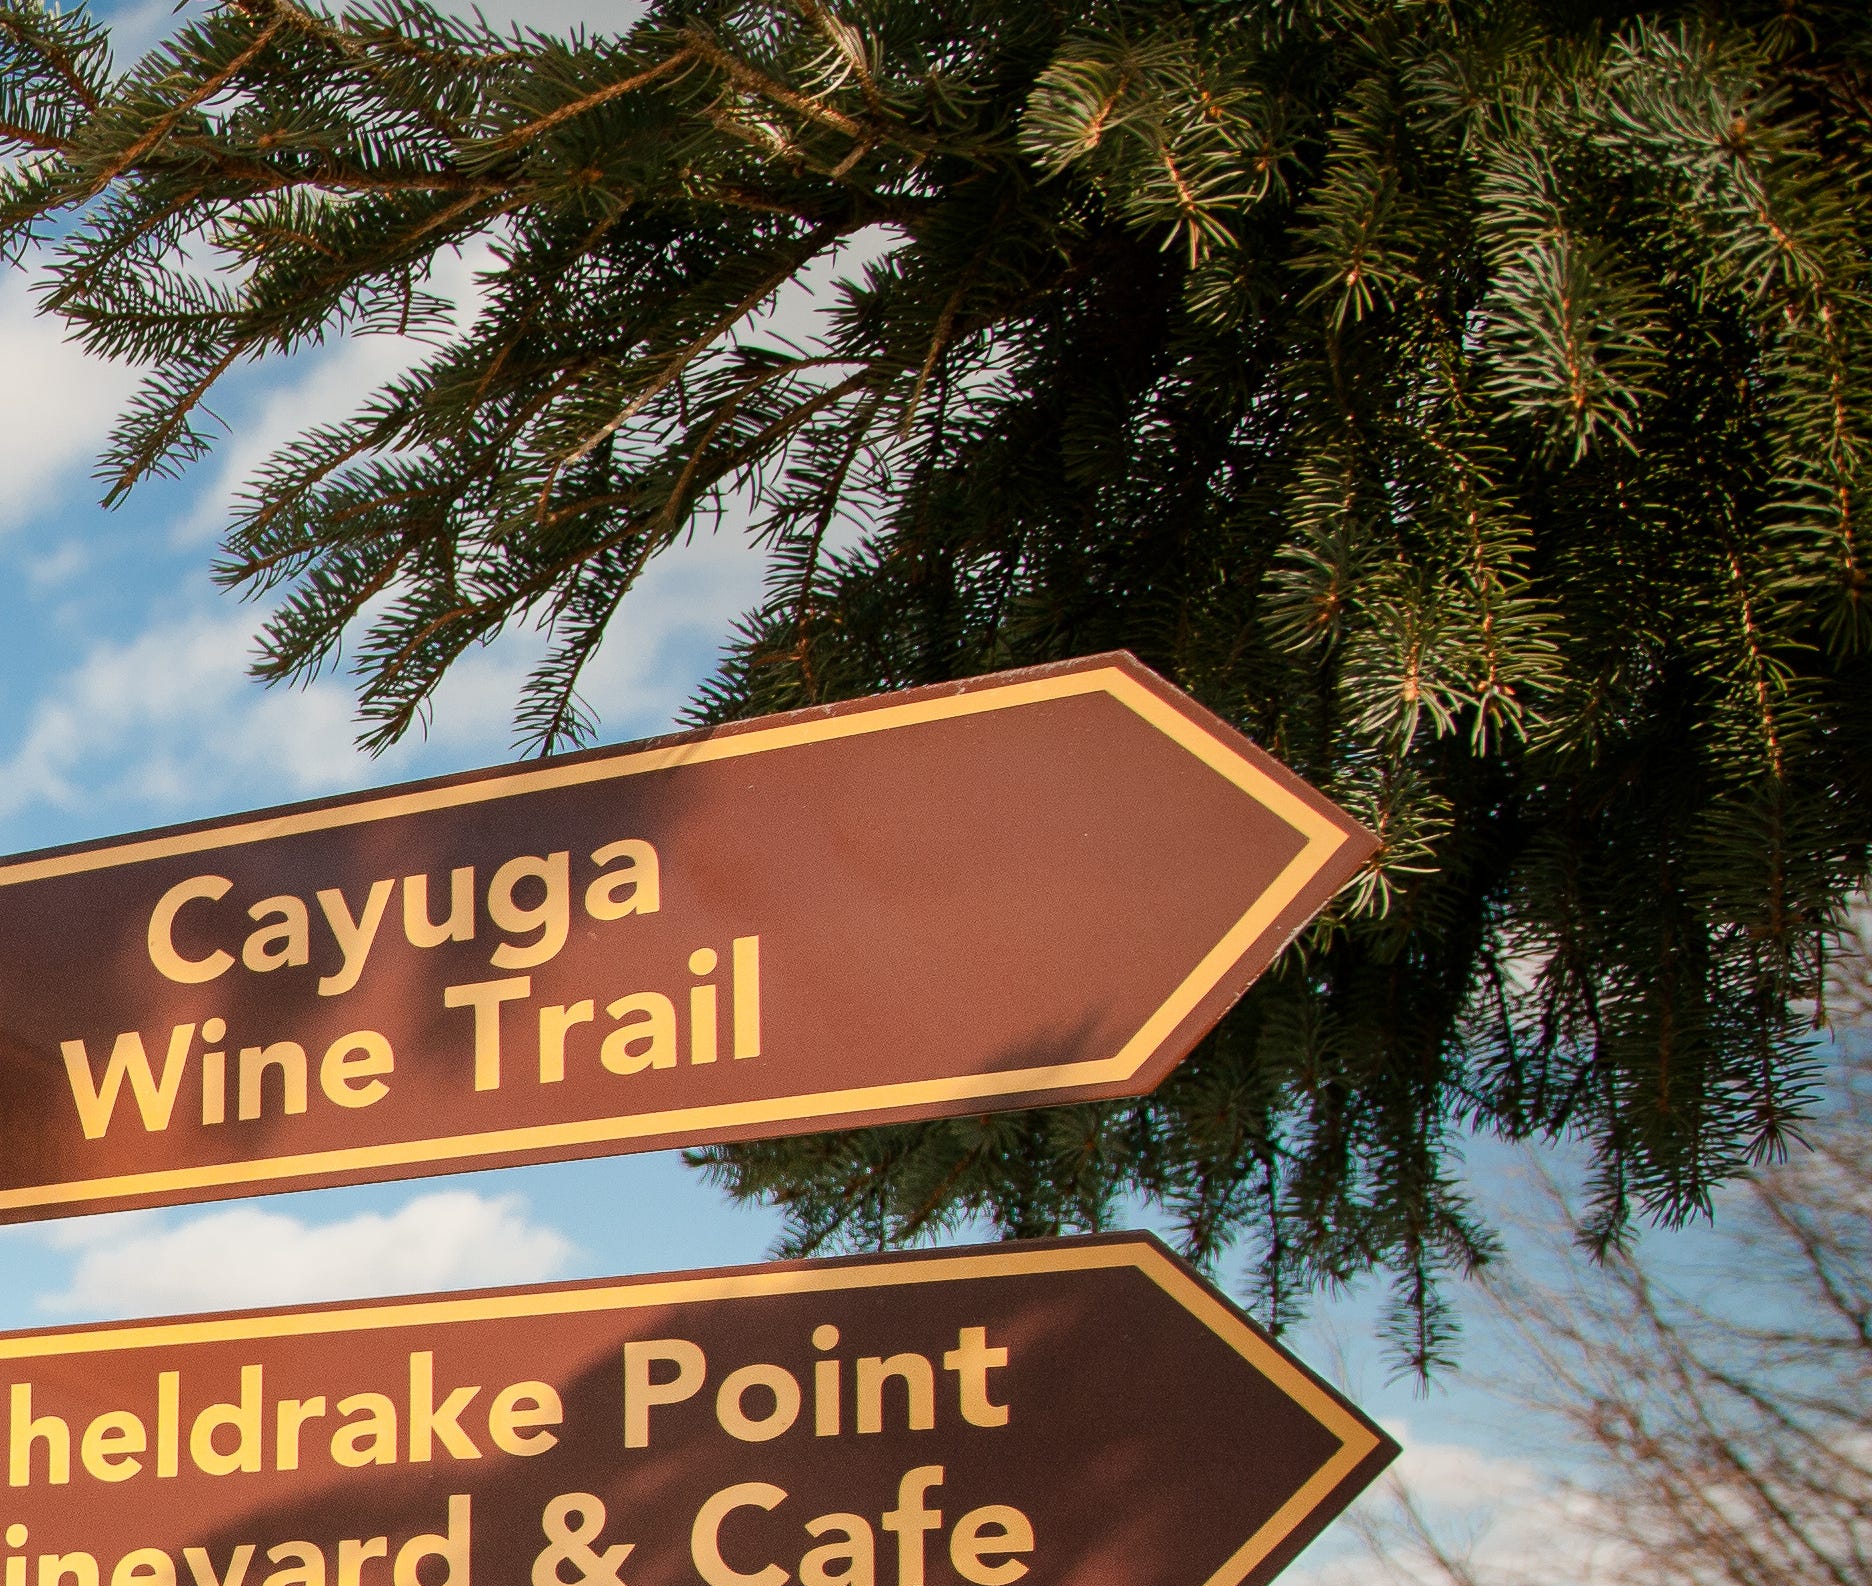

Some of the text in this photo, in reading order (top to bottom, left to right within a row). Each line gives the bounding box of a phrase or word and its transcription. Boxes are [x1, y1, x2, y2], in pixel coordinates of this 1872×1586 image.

[147, 839, 660, 997] Cayuga
[60, 935, 761, 1141] Wine Trail
[623, 1326, 1008, 1448] Point
